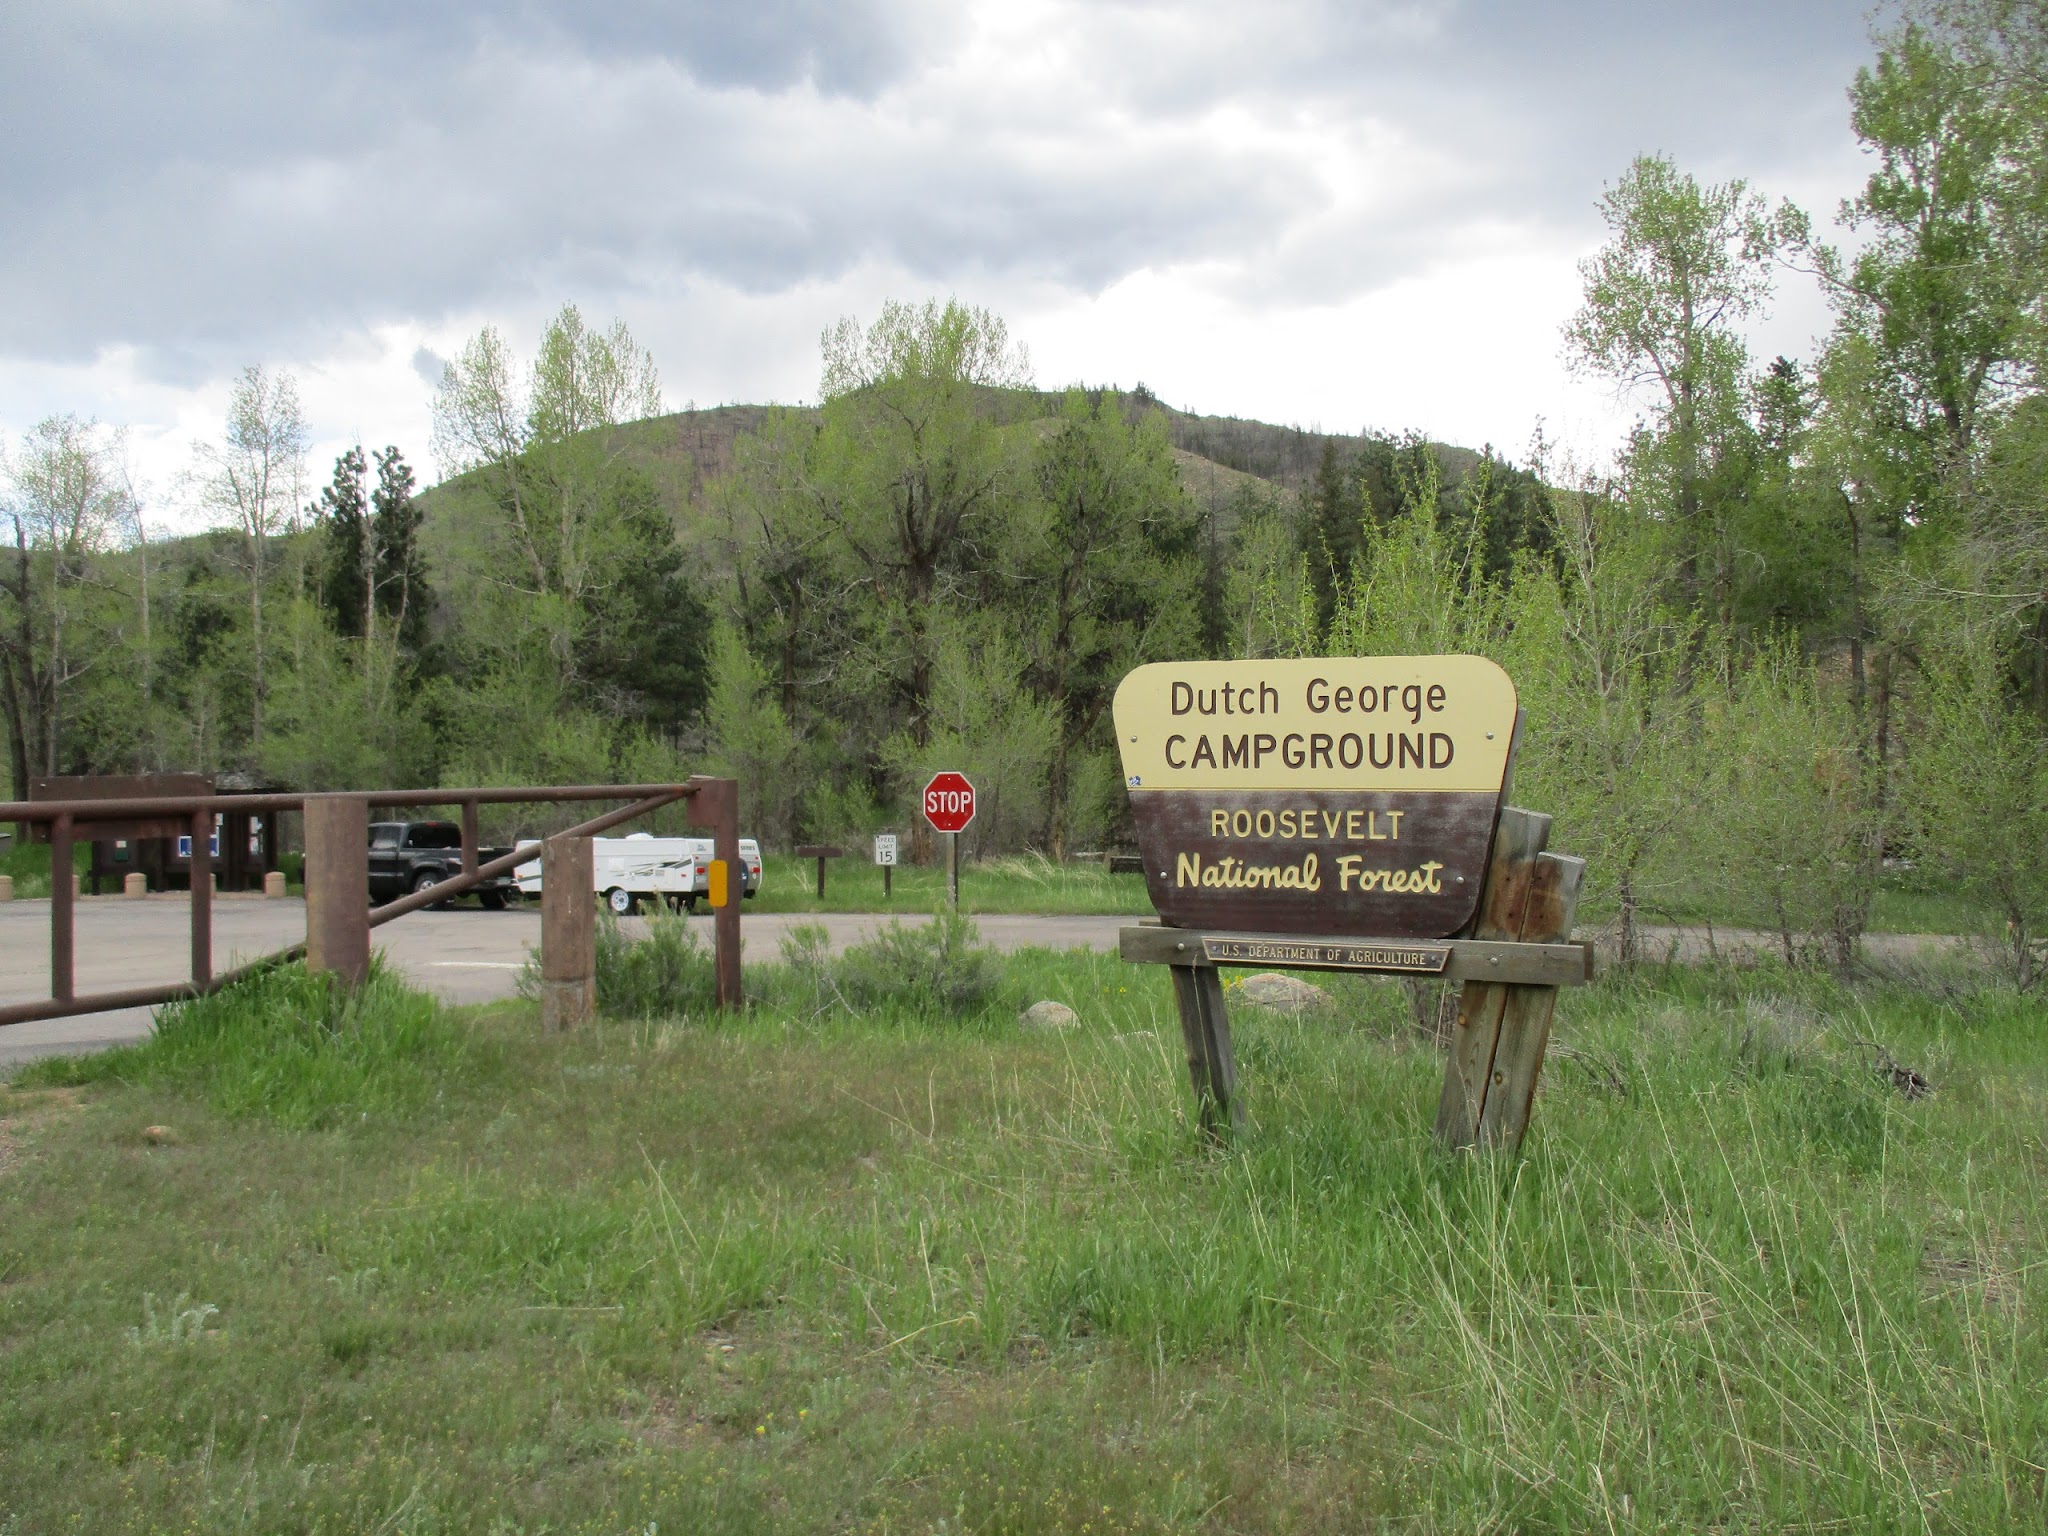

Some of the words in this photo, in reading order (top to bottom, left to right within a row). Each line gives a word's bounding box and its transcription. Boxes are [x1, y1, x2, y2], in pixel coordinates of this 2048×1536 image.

[1172, 680, 1279, 716] Dutch
[1306, 678, 1447, 724] George
[1165, 732, 1455, 769] CAMPGROUND
[927, 791, 972, 813] STOP
[1211, 808, 1404, 840] ROOSEVELT
[880, 851, 893, 862] 15
[1177, 852, 1321, 892] National
[1336, 854, 1444, 894] Forest
[1222, 944, 1242, 957] U.S.
[1248, 945, 1320, 961] DEPARTMENT
[1327, 949, 1341, 961] OF
[1348, 949, 1426, 966] AGRICULTURE
